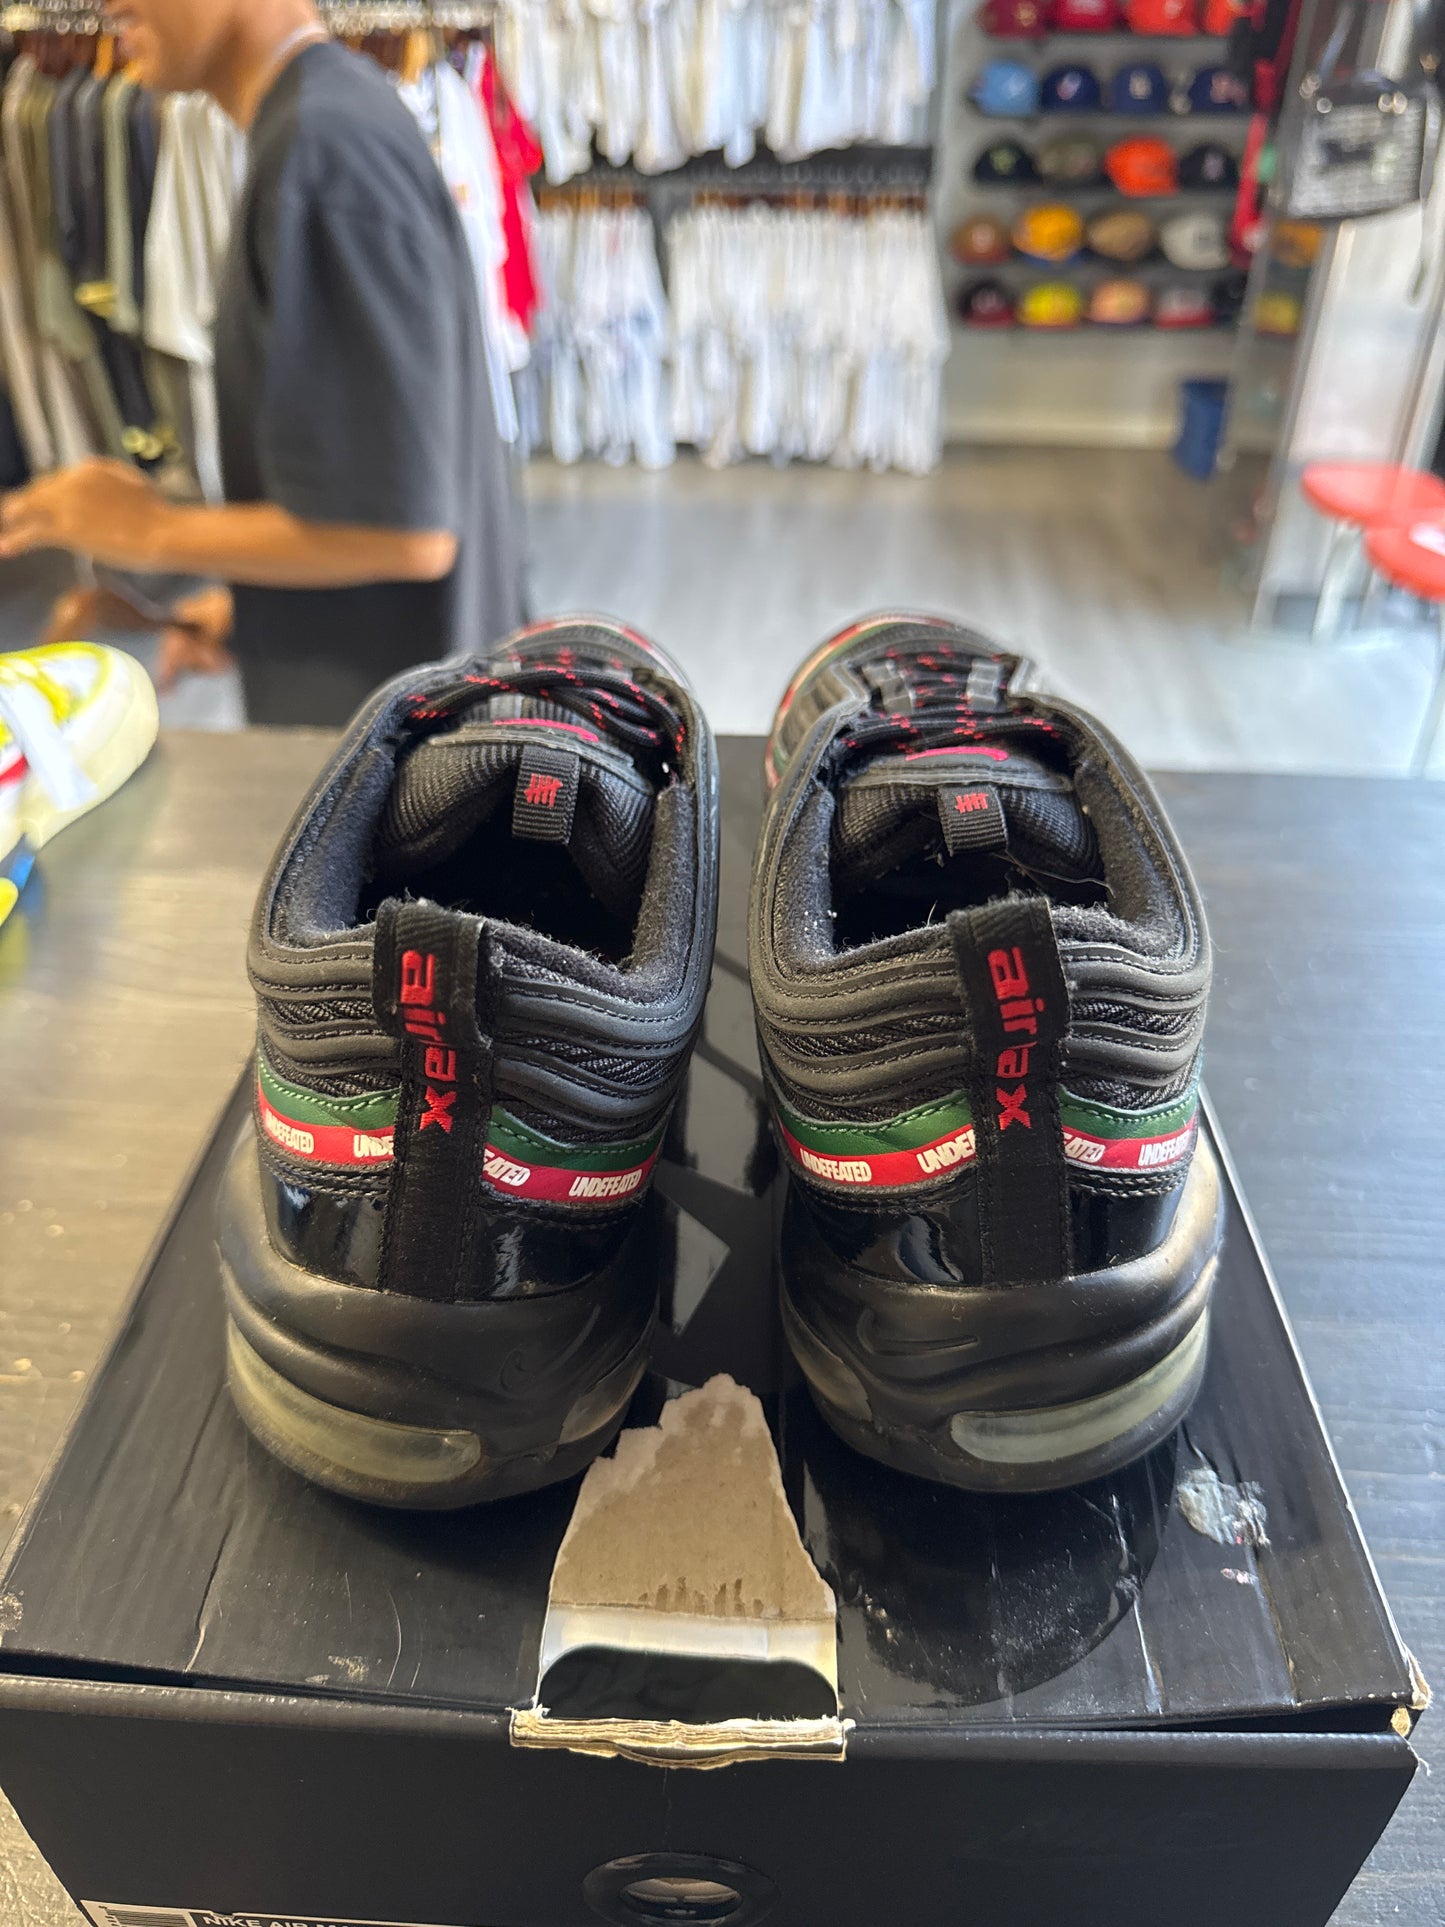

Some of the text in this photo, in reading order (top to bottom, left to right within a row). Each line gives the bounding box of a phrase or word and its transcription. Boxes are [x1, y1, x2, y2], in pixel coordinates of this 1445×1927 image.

[400, 949, 457, 1133] air ax
[987, 946, 1046, 1131] air ax
[265, 1108, 315, 1154] UNDEFEATED
[568, 1169, 643, 1197] UNDEFEATED
[799, 1147, 872, 1182] UNDEFEATED
[203, 1916, 262, 1927] NIKE
